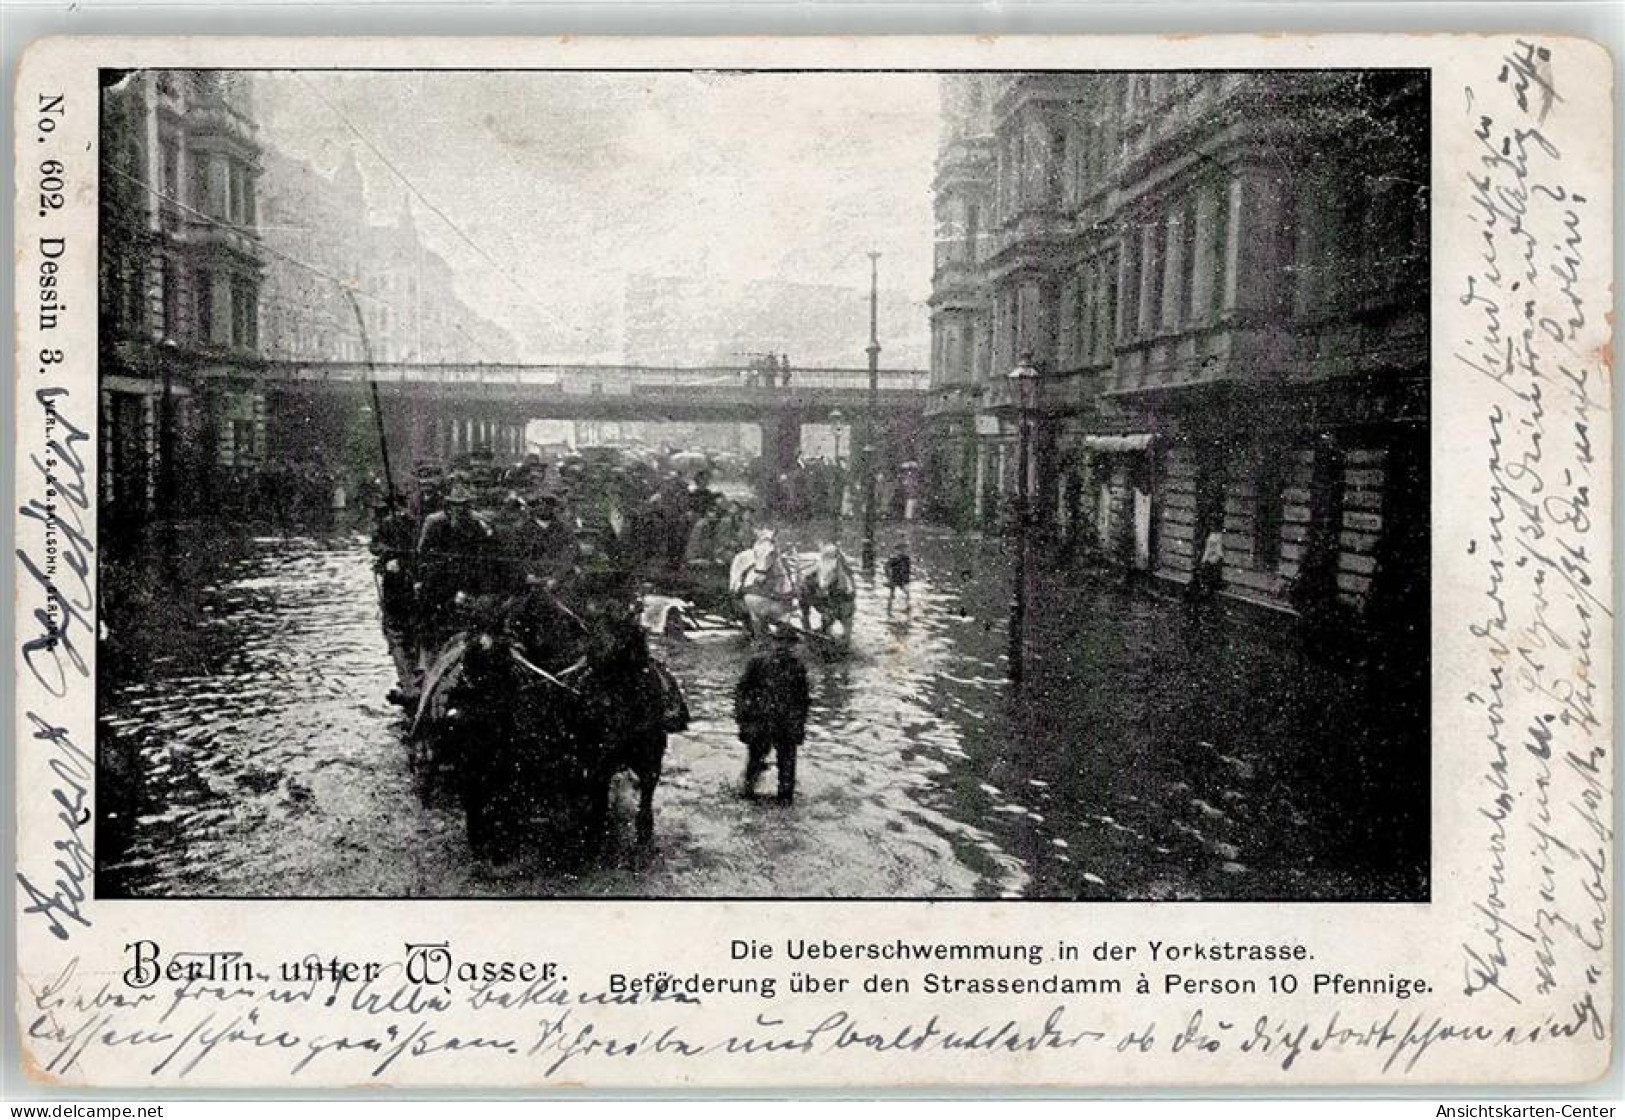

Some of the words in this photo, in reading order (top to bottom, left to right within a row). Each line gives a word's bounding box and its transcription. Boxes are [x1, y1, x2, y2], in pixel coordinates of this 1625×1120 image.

[37, 94, 65, 144] No.
[38, 159, 65, 218] 602.
[39, 237, 66, 331] Dessin
[38, 348, 64, 374] 3.
[124, 940, 253, 988] Berlin
[281, 953, 380, 984] unter
[404, 941, 569, 986] Wasser.
[731, 940, 773, 960] Die
[787, 939, 1044, 965] Ueberschwemmung
[1058, 940, 1079, 960] in
[1093, 941, 1137, 961] der
[1149, 941, 1315, 961] Yorkstrasse.
[610, 971, 776, 998] Beförderung
[789, 972, 850, 993] über
[863, 973, 909, 993] den
[923, 973, 1121, 994] Strassendamm
[1136, 971, 1151, 994] à
[1164, 975, 1256, 994] Person
[1270, 975, 1298, 994] 10
[1314, 974, 1434, 999] Pfennige.
